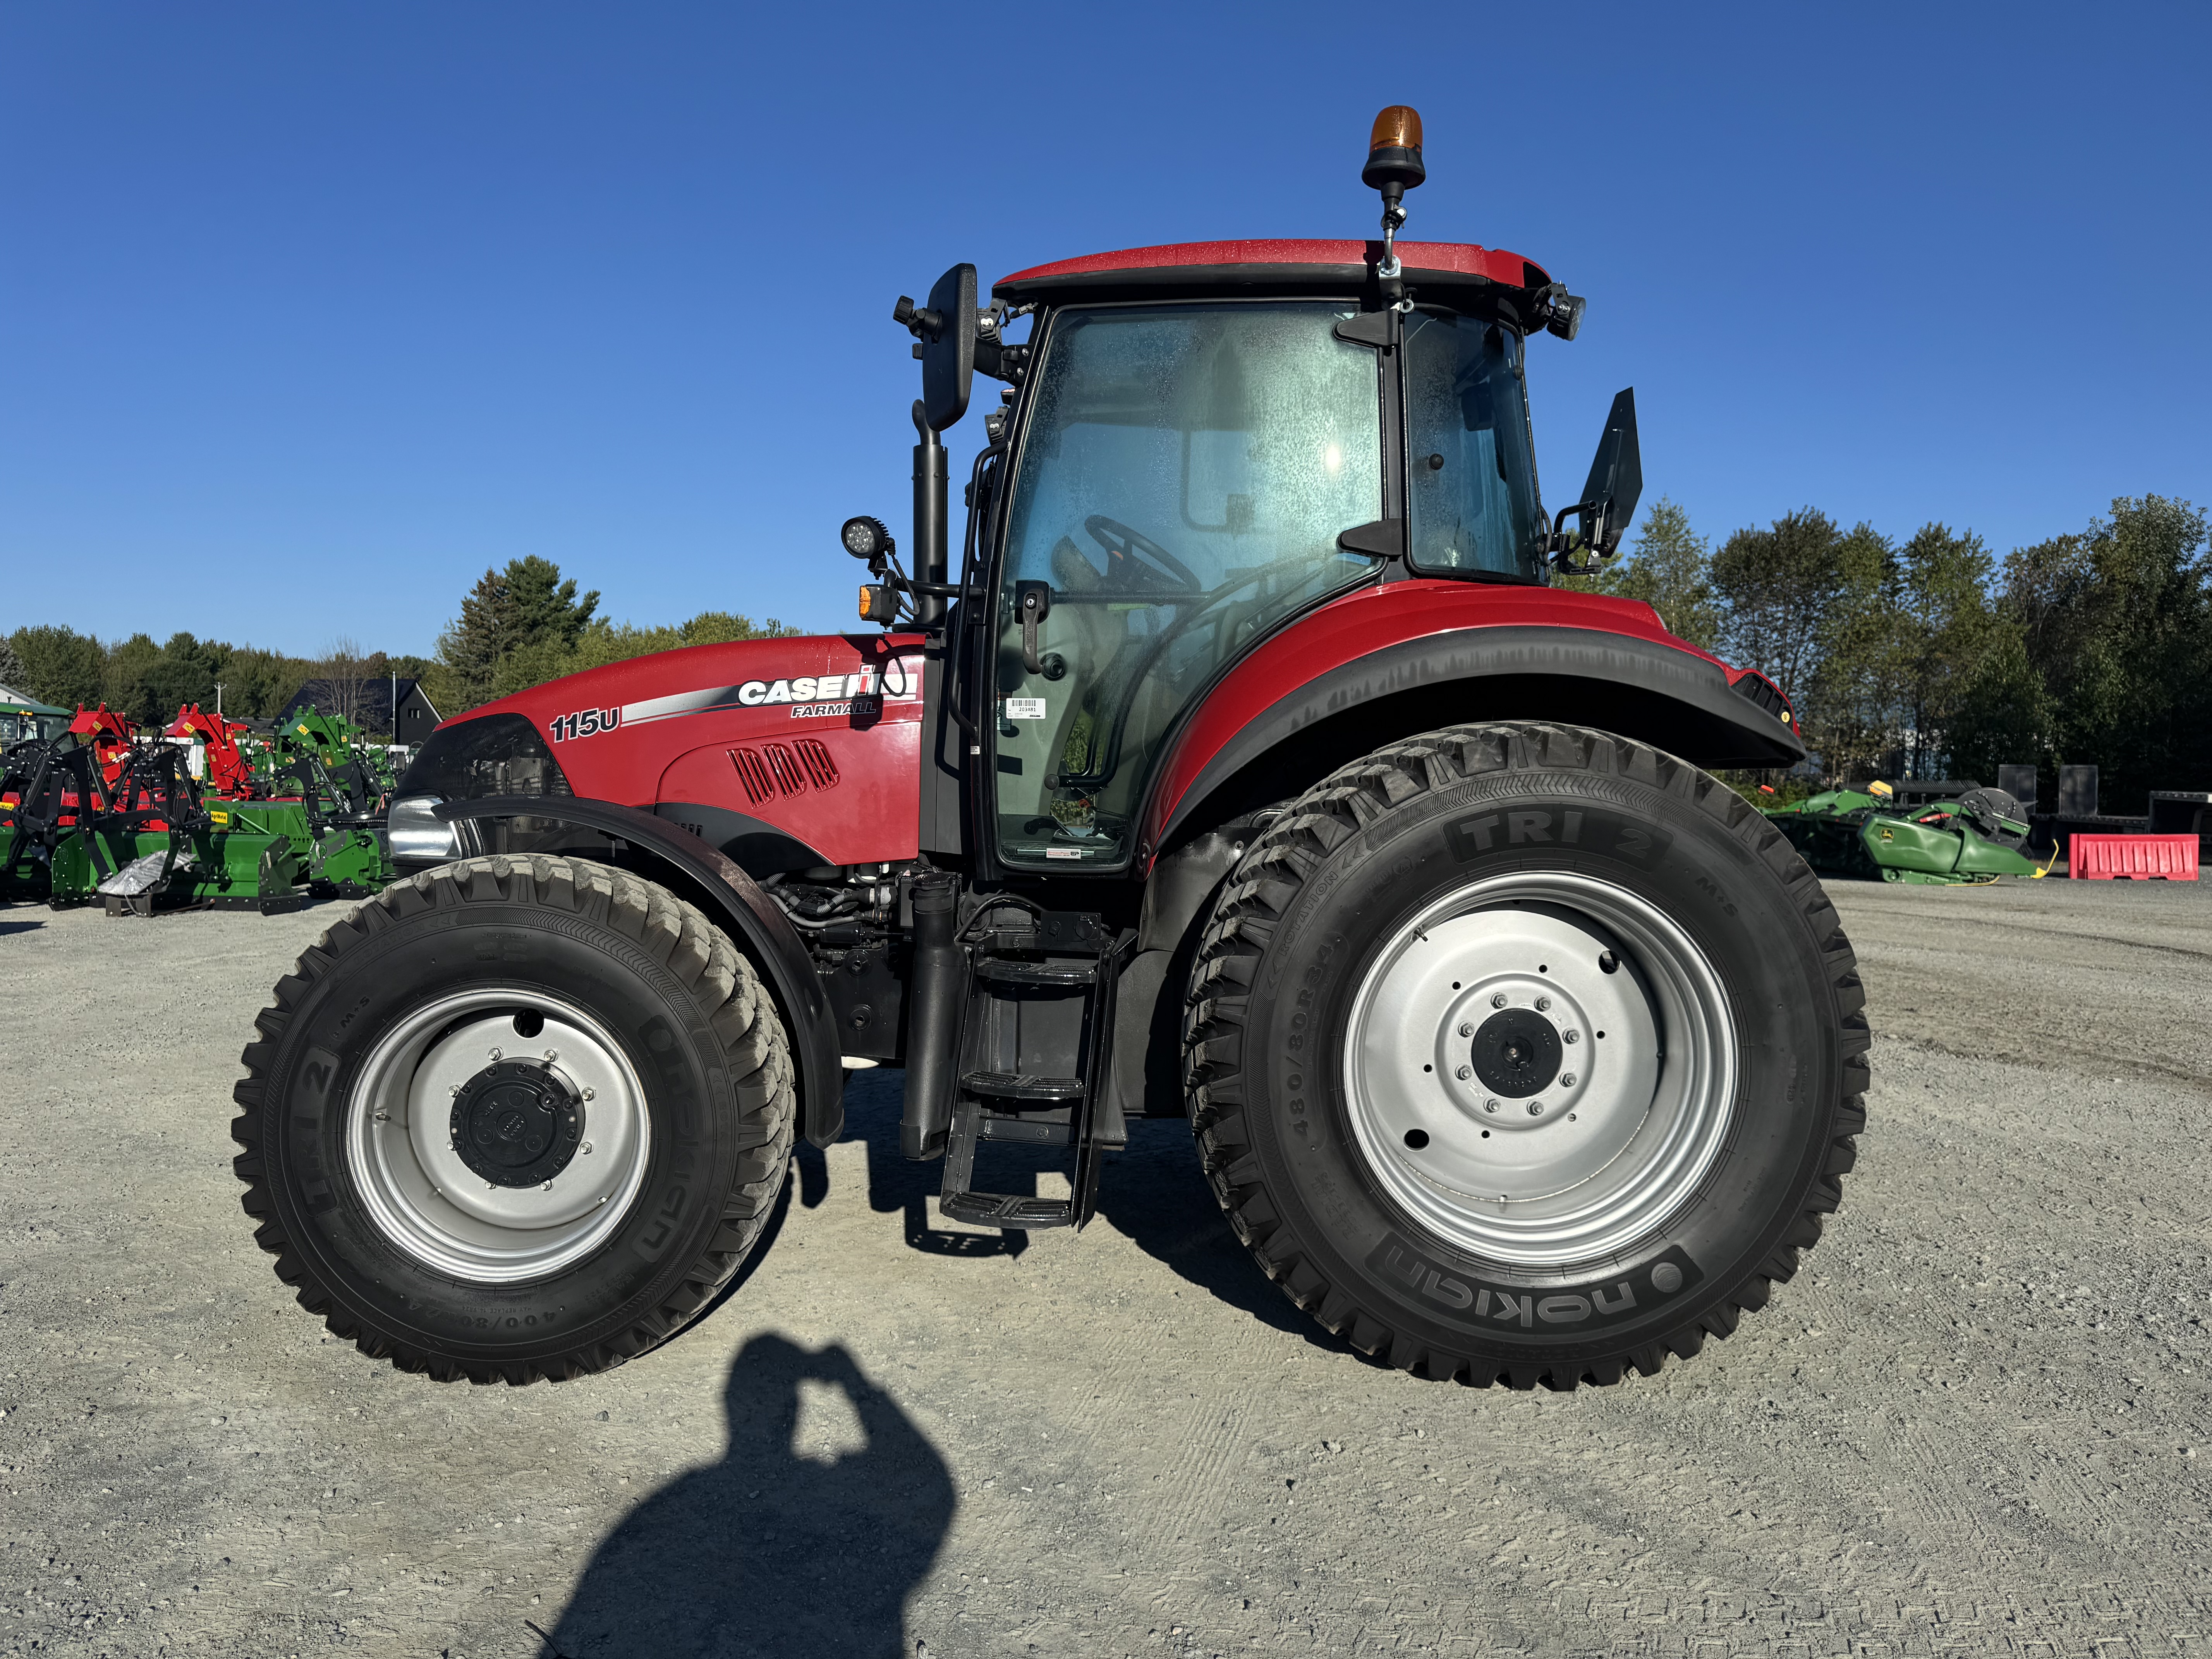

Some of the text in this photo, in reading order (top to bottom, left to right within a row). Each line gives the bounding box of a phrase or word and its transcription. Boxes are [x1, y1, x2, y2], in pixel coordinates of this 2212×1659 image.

[737, 675, 844, 706] CASE
[790, 702, 876, 718] FARMALL
[550, 707, 619, 743] 115U
[1459, 809, 1652, 860] TRI 2
[1278, 869, 1338, 957] ROTATION
[1695, 876, 1740, 919] M+S
[353, 923, 426, 965] ROTATION
[340, 996, 370, 1029] M+S
[294, 1115, 329, 1206] TRI
[1311, 1176, 1355, 1240] RADIAL
[489, 1305, 517, 1314] REPLACE
